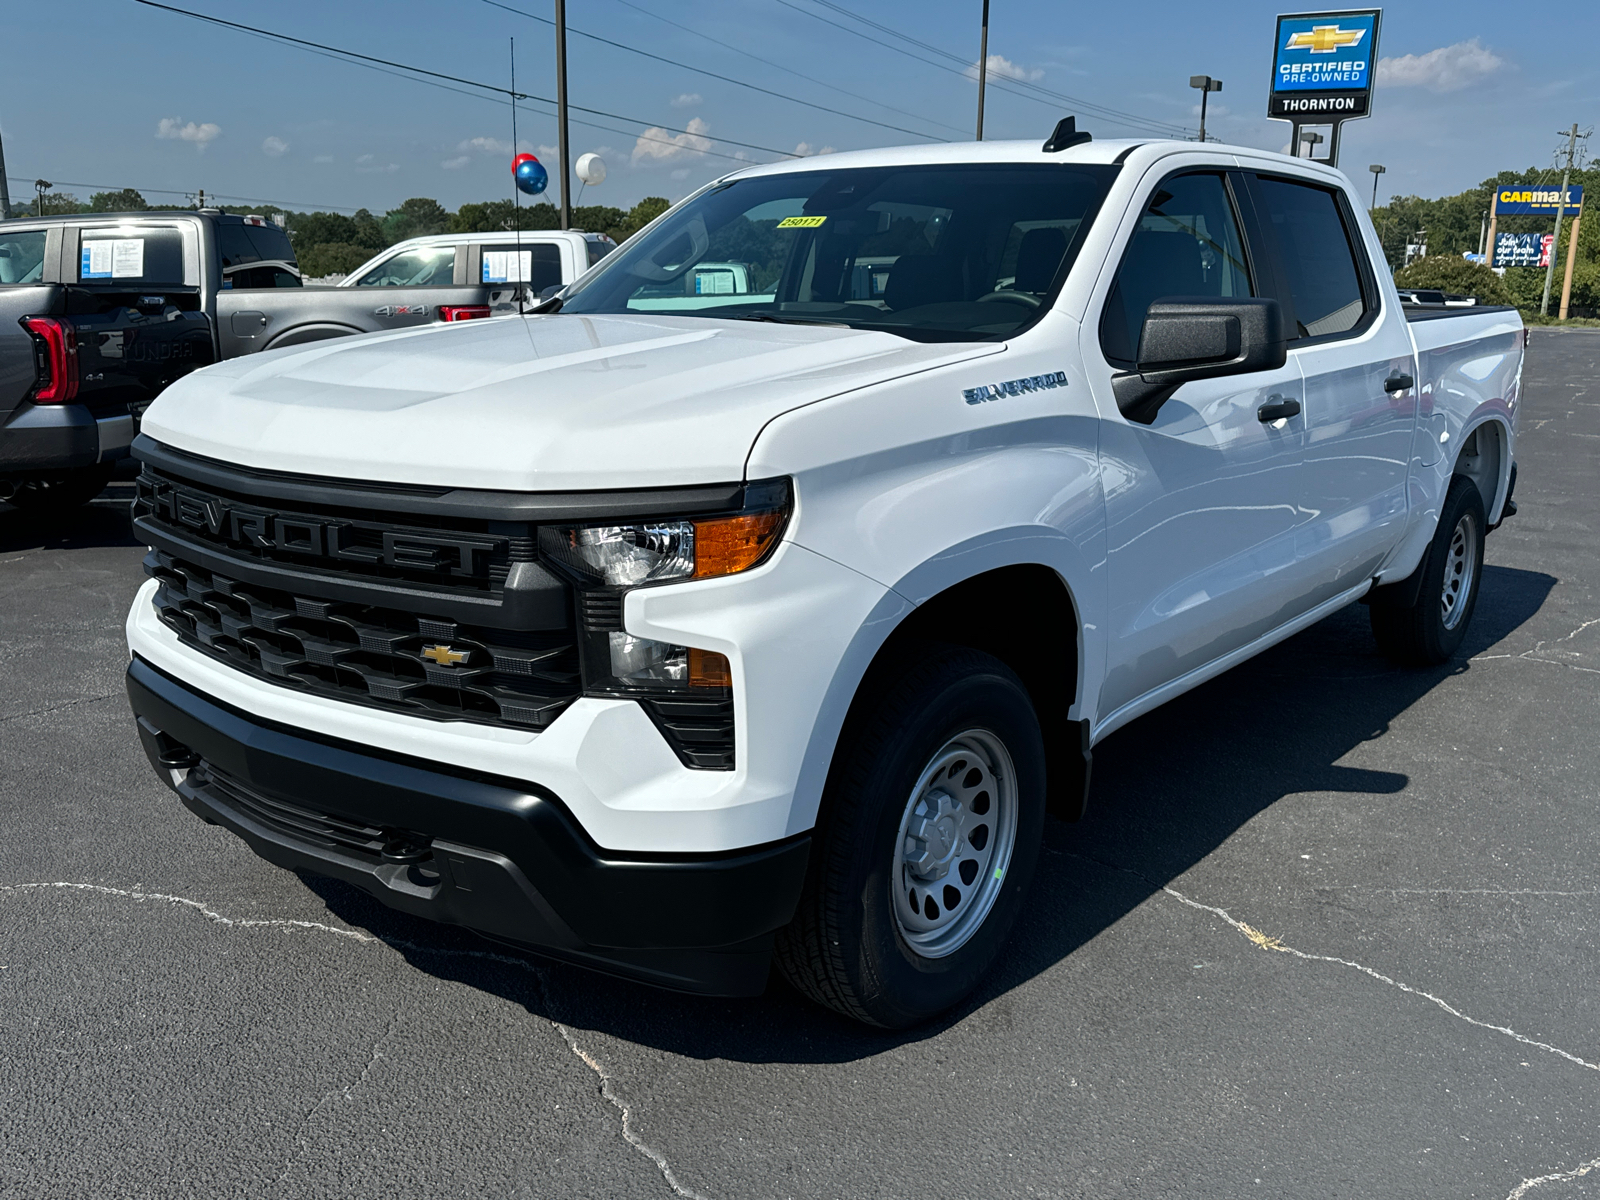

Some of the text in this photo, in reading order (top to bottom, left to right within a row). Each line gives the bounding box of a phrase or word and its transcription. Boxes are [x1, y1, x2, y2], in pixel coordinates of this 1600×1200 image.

[1280, 61, 1365, 74] CERTIFIED
[1283, 72, 1360, 83] PRE-OWNED
[1283, 98, 1355, 111] THORNTON
[780, 217, 822, 227] 250171
[961, 370, 1068, 405] SILVERADO
[136, 474, 508, 575] CHEVROLET
